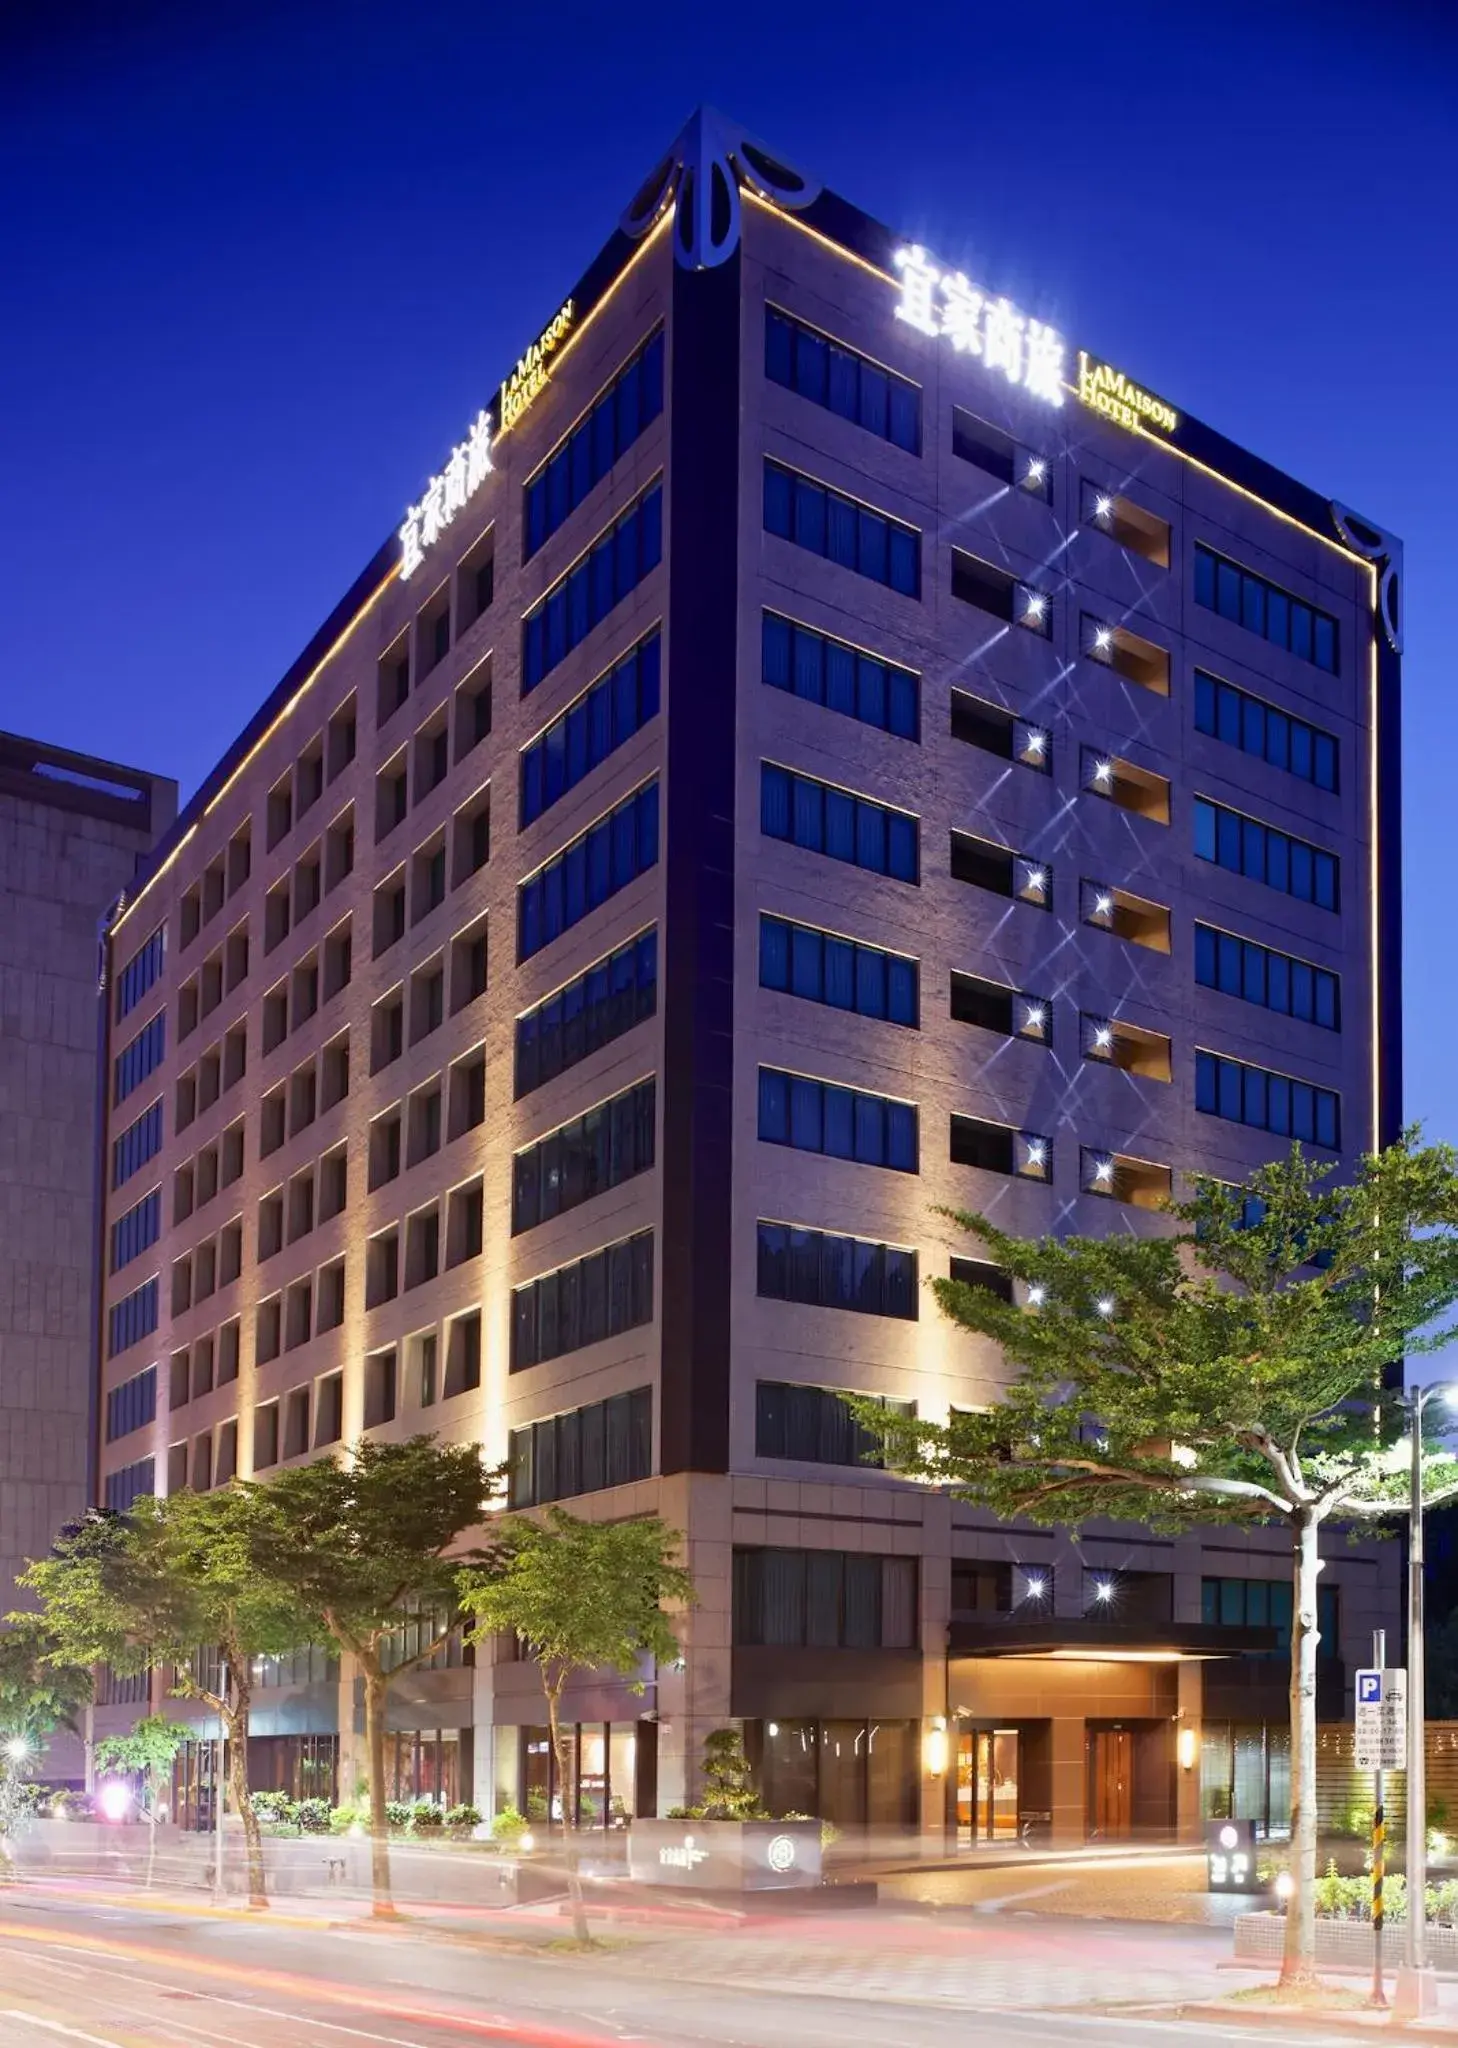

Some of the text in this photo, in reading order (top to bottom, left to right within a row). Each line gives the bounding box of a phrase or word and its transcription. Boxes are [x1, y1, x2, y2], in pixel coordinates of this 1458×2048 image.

[501, 364, 550, 431] HOTEL
[1080, 371, 1144, 435] HOTEL
[1362, 1677, 1378, 1698] P
